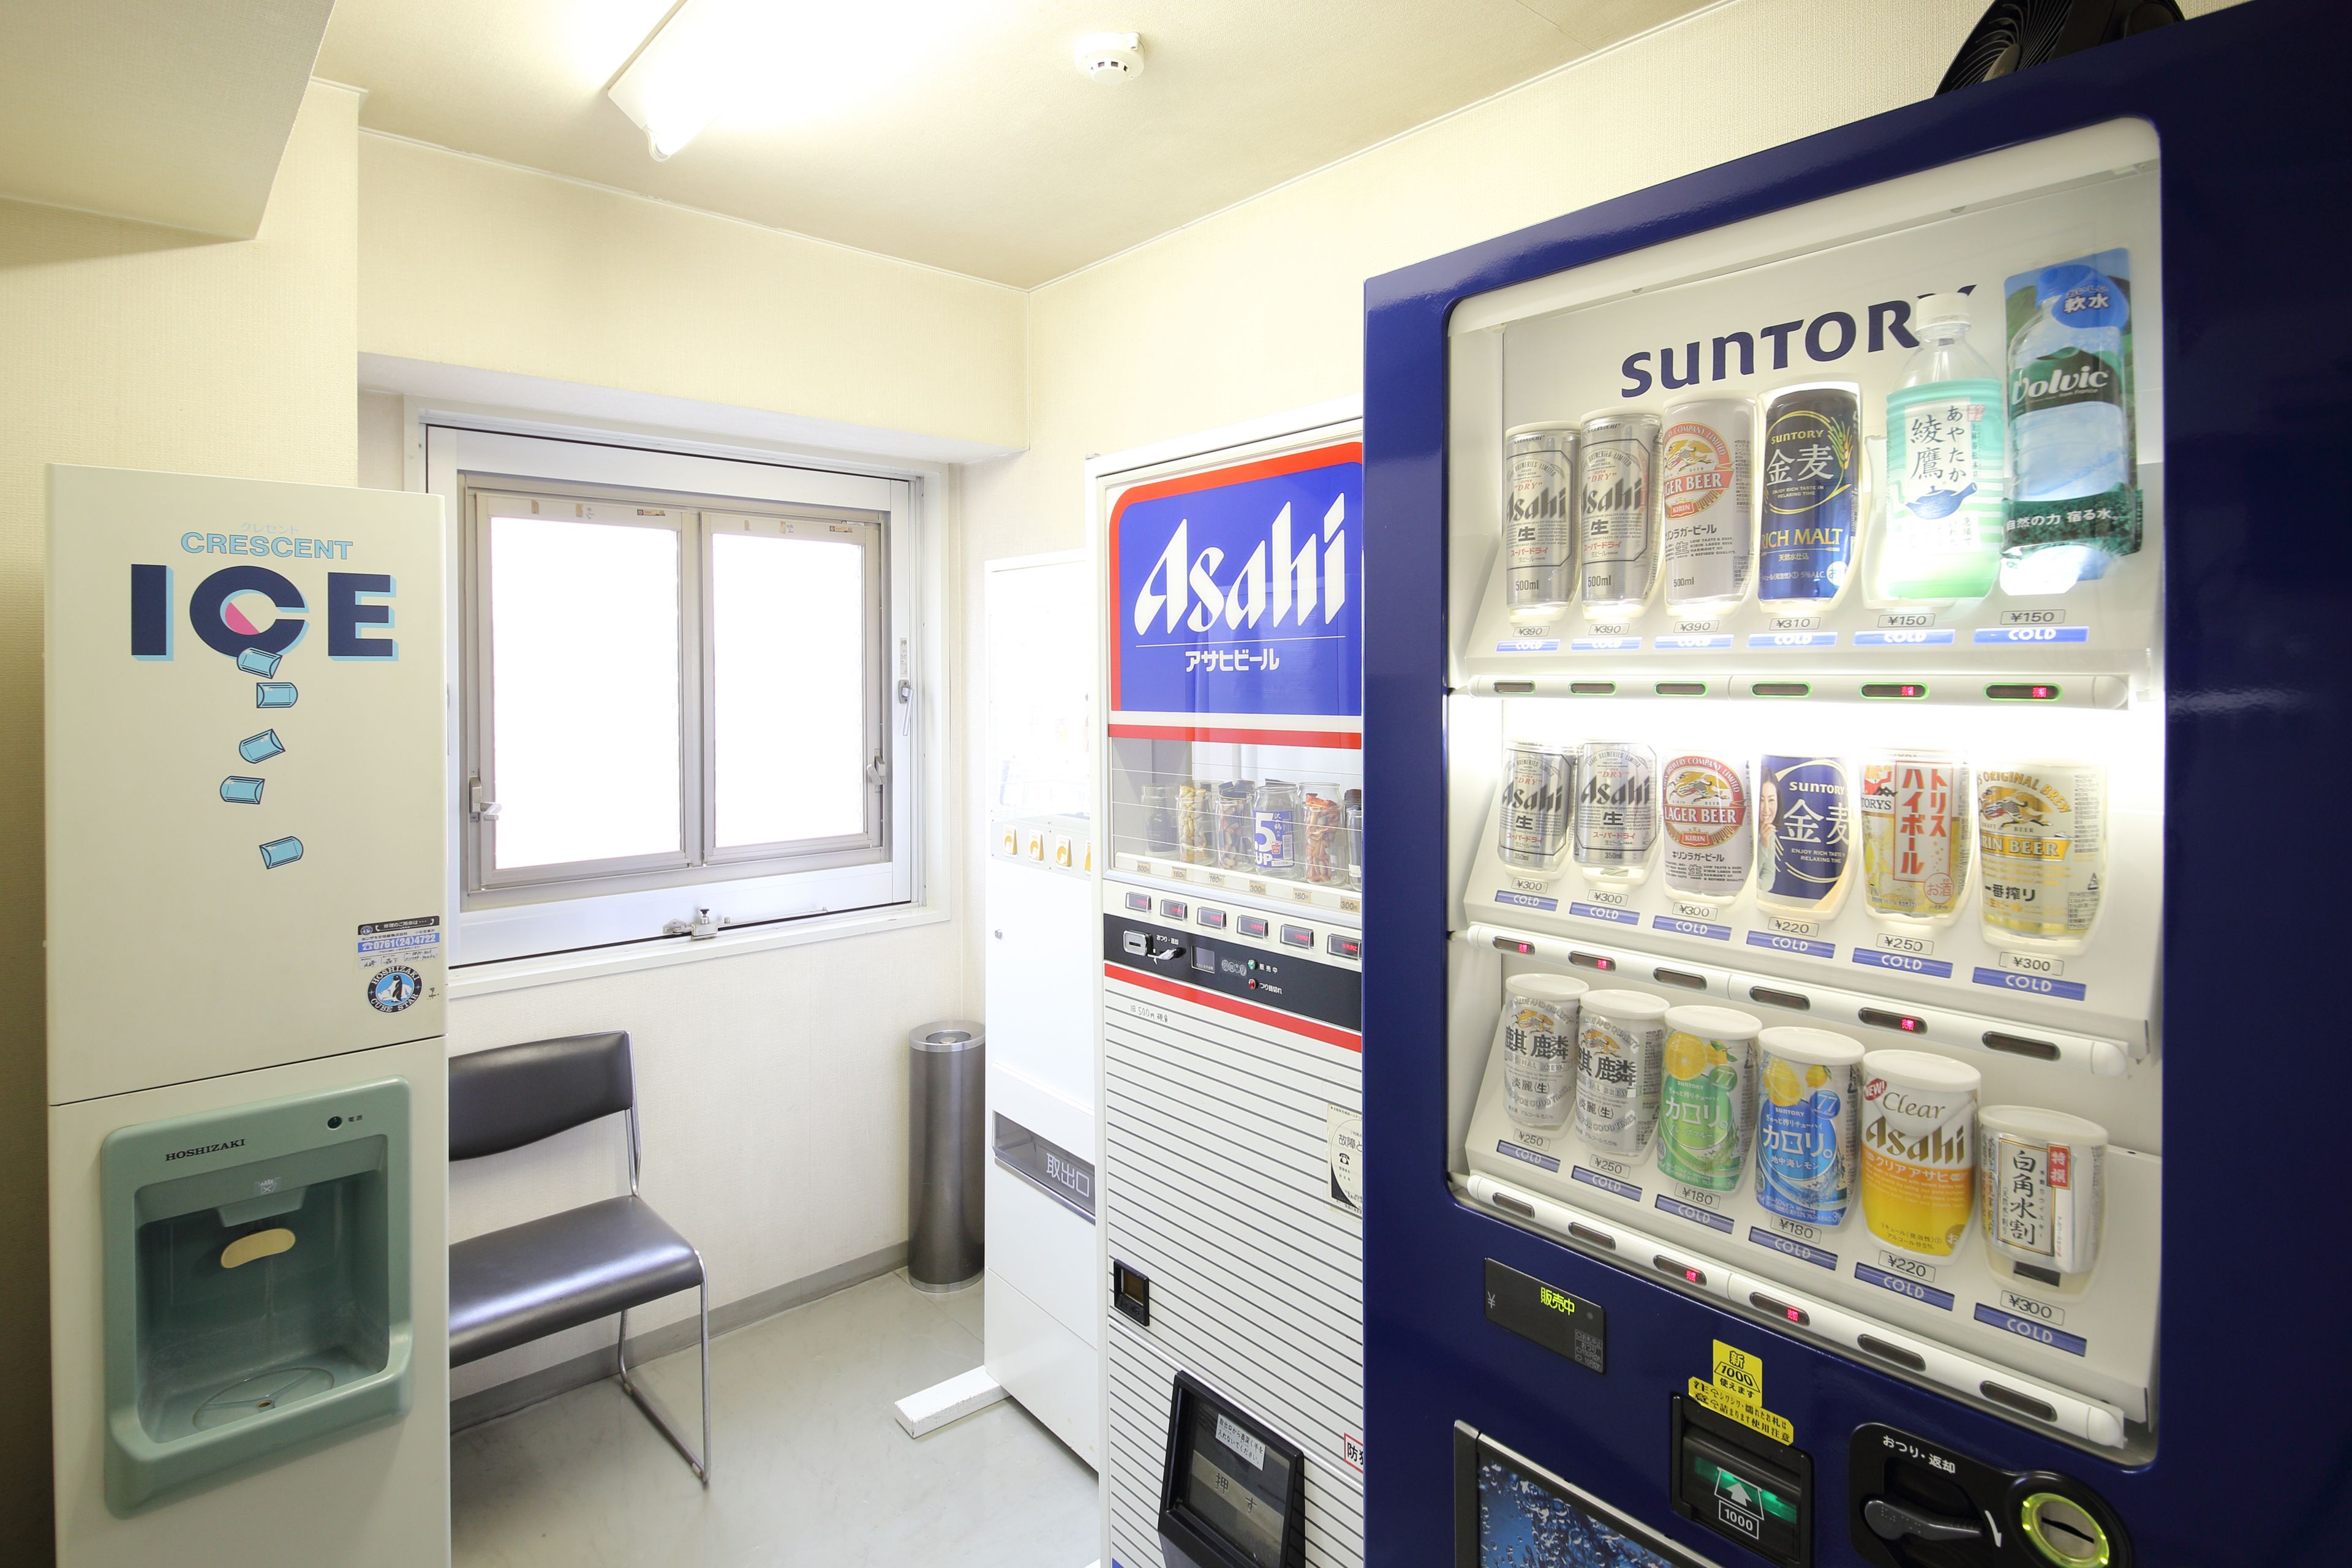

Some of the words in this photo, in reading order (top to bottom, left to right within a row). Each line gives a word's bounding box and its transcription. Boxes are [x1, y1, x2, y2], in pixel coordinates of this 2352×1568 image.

[2064, 293, 2109, 314] 軟水
[1622, 284, 1977, 398] SUNTOR
[2012, 366, 2108, 405] Volvic
[1771, 429, 1824, 445] SUNTORY
[1947, 405, 1966, 482] あやたか
[1910, 415, 1945, 479] 綾鷹
[1766, 444, 1834, 486] 金麦
[1686, 473, 1722, 491] BEER
[1673, 503, 1691, 513] KIRIN
[1591, 519, 1608, 535] 生
[2006, 513, 2061, 532] 自然の力
[2067, 508, 2119, 523] 宿る水。
[1518, 526, 1536, 541] 生
[1793, 527, 1844, 545] MALT
[181, 532, 353, 560] CRESCENT
[1510, 547, 1548, 557] スーパードライ
[1134, 492, 1345, 636] Asahi
[1515, 579, 1539, 591] 500ml
[1588, 575, 1611, 587] 500ml
[1673, 577, 1694, 587] 500ml
[131, 564, 399, 662] ICE
[1888, 614, 1927, 626] ¥150
[2010, 611, 2054, 623] ¥150
[1518, 627, 1543, 636] ¥390
[1594, 625, 1621, 634] ¥390
[1679, 622, 1711, 632] ¥390
[1776, 619, 1811, 629] ¥310
[1883, 629, 1928, 643] COLD
[2008, 628, 2056, 641] COLD
[1185, 648, 1280, 673] アサヒビール
[1515, 776, 1543, 786] "DRY"
[1581, 775, 1650, 805] Asahi
[1722, 769, 1740, 793] LIMITED
[1789, 781, 1845, 795] SUNTORY
[1502, 780, 1563, 812] Asahi
[1983, 771, 2040, 790] ORIGINAL
[2040, 784, 2072, 813] BREW
[1929, 769, 1948, 837] トリス
[1515, 815, 1533, 830] 生
[1603, 811, 1624, 826] 生
[1664, 806, 1697, 822] LAGER
[1701, 809, 1736, 823] BEER
[1779, 798, 1849, 845] 金麦
[1900, 769, 1925, 875] ハイボール
[1507, 832, 1543, 843] スーパードライ
[1514, 853, 1529, 861] 350ml
[1672, 851, 1725, 862] キリンラガービール
[2008, 840, 2060, 856] BEER
[1255, 852, 1273, 865] UP
[1517, 881, 1542, 891] ¥300
[1927, 878, 1952, 897] お酒
[1985, 883, 2035, 902] 一番搾り
[1513, 895, 1540, 907] COLD
[1594, 892, 1623, 904] ¥300
[1590, 907, 1619, 920] COLD
[1679, 905, 1710, 917] ¥300
[1676, 921, 1708, 935] COLD
[1774, 919, 1809, 935] ¥220
[373, 934, 436, 950] 0761(24)4722
[1772, 937, 1809, 952] COLD
[1885, 937, 1923, 952] ¥250
[1259, 963, 1278, 974] 販売中
[1881, 954, 1923, 971] COLD
[2013, 956, 2051, 972] ¥300
[371, 966, 420, 986] HOSHIZAKI
[2005, 974, 2052, 993] COLD
[370, 998, 393, 1012] CUBE
[398, 993, 419, 1011] STAR
[1506, 1025, 1569, 1060] 麒麟
[1677, 1080, 1704, 1090] SUNTORY
[1716, 1069, 1735, 1087] 77
[1864, 1080, 1885, 1098] NEW!
[1775, 1107, 1805, 1117] SUNTORY
[1817, 1094, 1838, 1112] 77
[1882, 1091, 1945, 1119] Clear
[1518, 1133, 1544, 1147] ¥250
[1866, 1116, 1964, 1164] Asahi
[165, 1138, 246, 1162] HOSHIZAKI
[1515, 1148, 1542, 1164] COLD
[1594, 1156, 1623, 1174] ¥250
[1771, 1155, 1819, 1170] 地中海レモン
[1876, 1156, 1949, 1183] クリアアサヒ
[1046, 1153, 1090, 1198] 取出口
[1592, 1176, 1622, 1193] COLD
[1681, 1187, 1713, 1206] ¥180
[2010, 1150, 2037, 1245] 白角水割
[1678, 1205, 1711, 1224] COLD
[1779, 1218, 1814, 1240] ¥180
[1774, 1238, 1812, 1260] COLD
[1888, 1254, 1926, 1278] ¥220
[1884, 1275, 1924, 1300] COLD
[1540, 1287, 1575, 1316] 販売中
[2009, 1293, 2052, 1319] ¥300
[2006, 1318, 2054, 1346] COLD
[1729, 1350, 1745, 1370] 新
[1721, 1365, 1753, 1387] 1000
[1720, 1378, 1755, 1398] 使えます
[1883, 1434, 1956, 1474] おつり・返却
[1724, 1508, 1754, 1531] 1000
